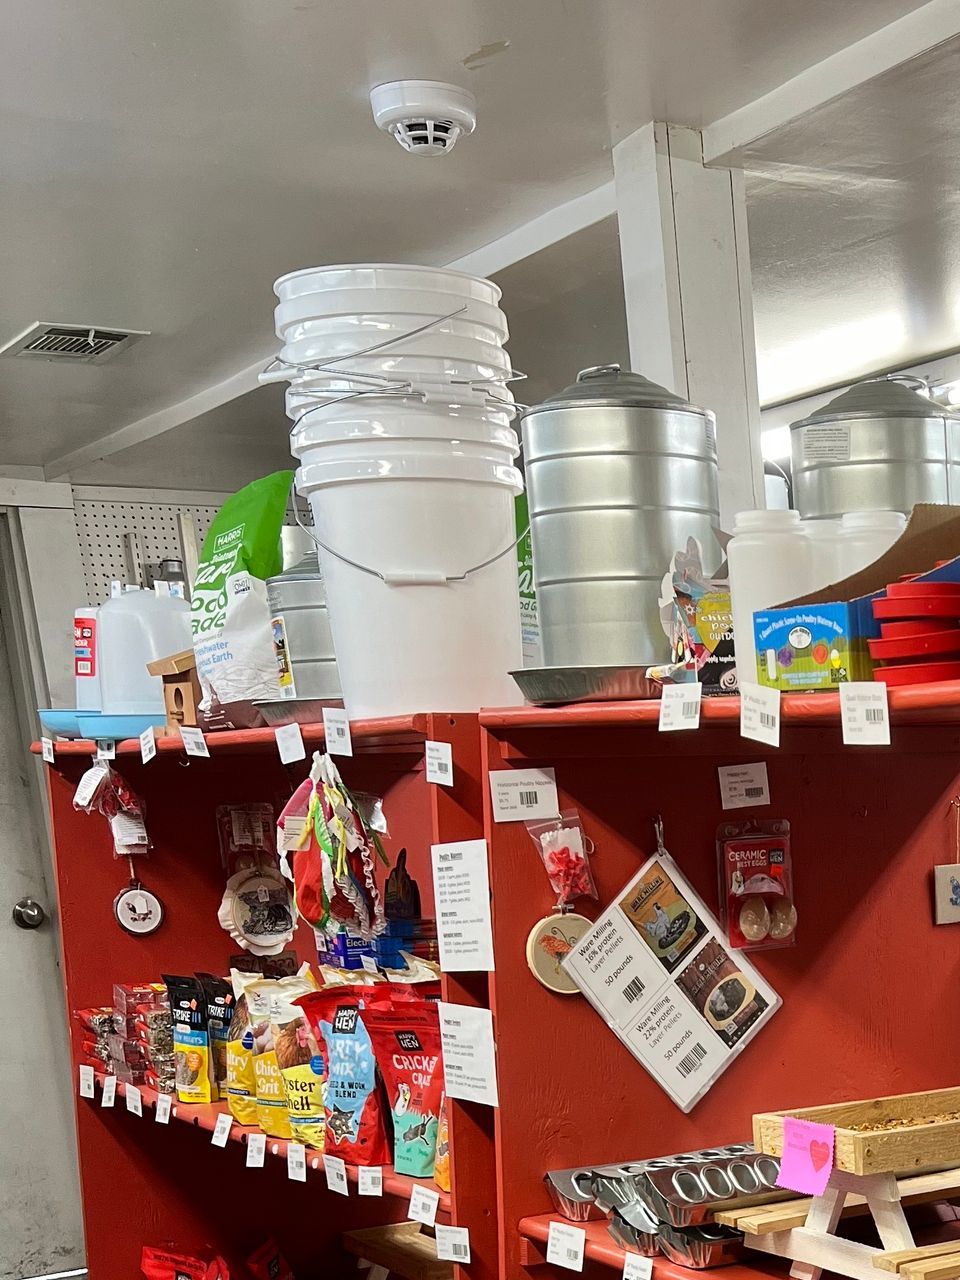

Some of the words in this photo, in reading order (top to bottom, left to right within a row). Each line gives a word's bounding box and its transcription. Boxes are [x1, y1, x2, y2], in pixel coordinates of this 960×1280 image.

[218, 527, 241, 545] HARRIS
[212, 652, 233, 663] Earth
[729, 850, 767, 862] CERAMIC
[750, 859, 767, 867] EGGS
[578, 936, 595, 957] Ware
[592, 919, 613, 941] Milling
[585, 949, 599, 965] 16%
[598, 927, 618, 953] protein
[591, 955, 606, 974] Layer
[605, 935, 624, 957] Pellets
[604, 973, 616, 987] 50
[613, 955, 634, 980] pounds
[338, 1009, 358, 1020] HAPPY
[635, 1013, 652, 1033] Ware
[650, 995, 671, 1017] Milling
[643, 1025, 657, 1041] 22%
[655, 1004, 676, 1030] protein
[335, 1017, 355, 1030] HEN
[648, 1030, 664, 1049] Layer
[663, 1012, 683, 1032] Pellets
[401, 1039, 419, 1048] HEN
[664, 1048, 674, 1061] 50
[672, 1030, 693, 1054] pounds
[258, 1078, 279, 1095] Grit
[336, 1090, 357, 1098] BLEND
